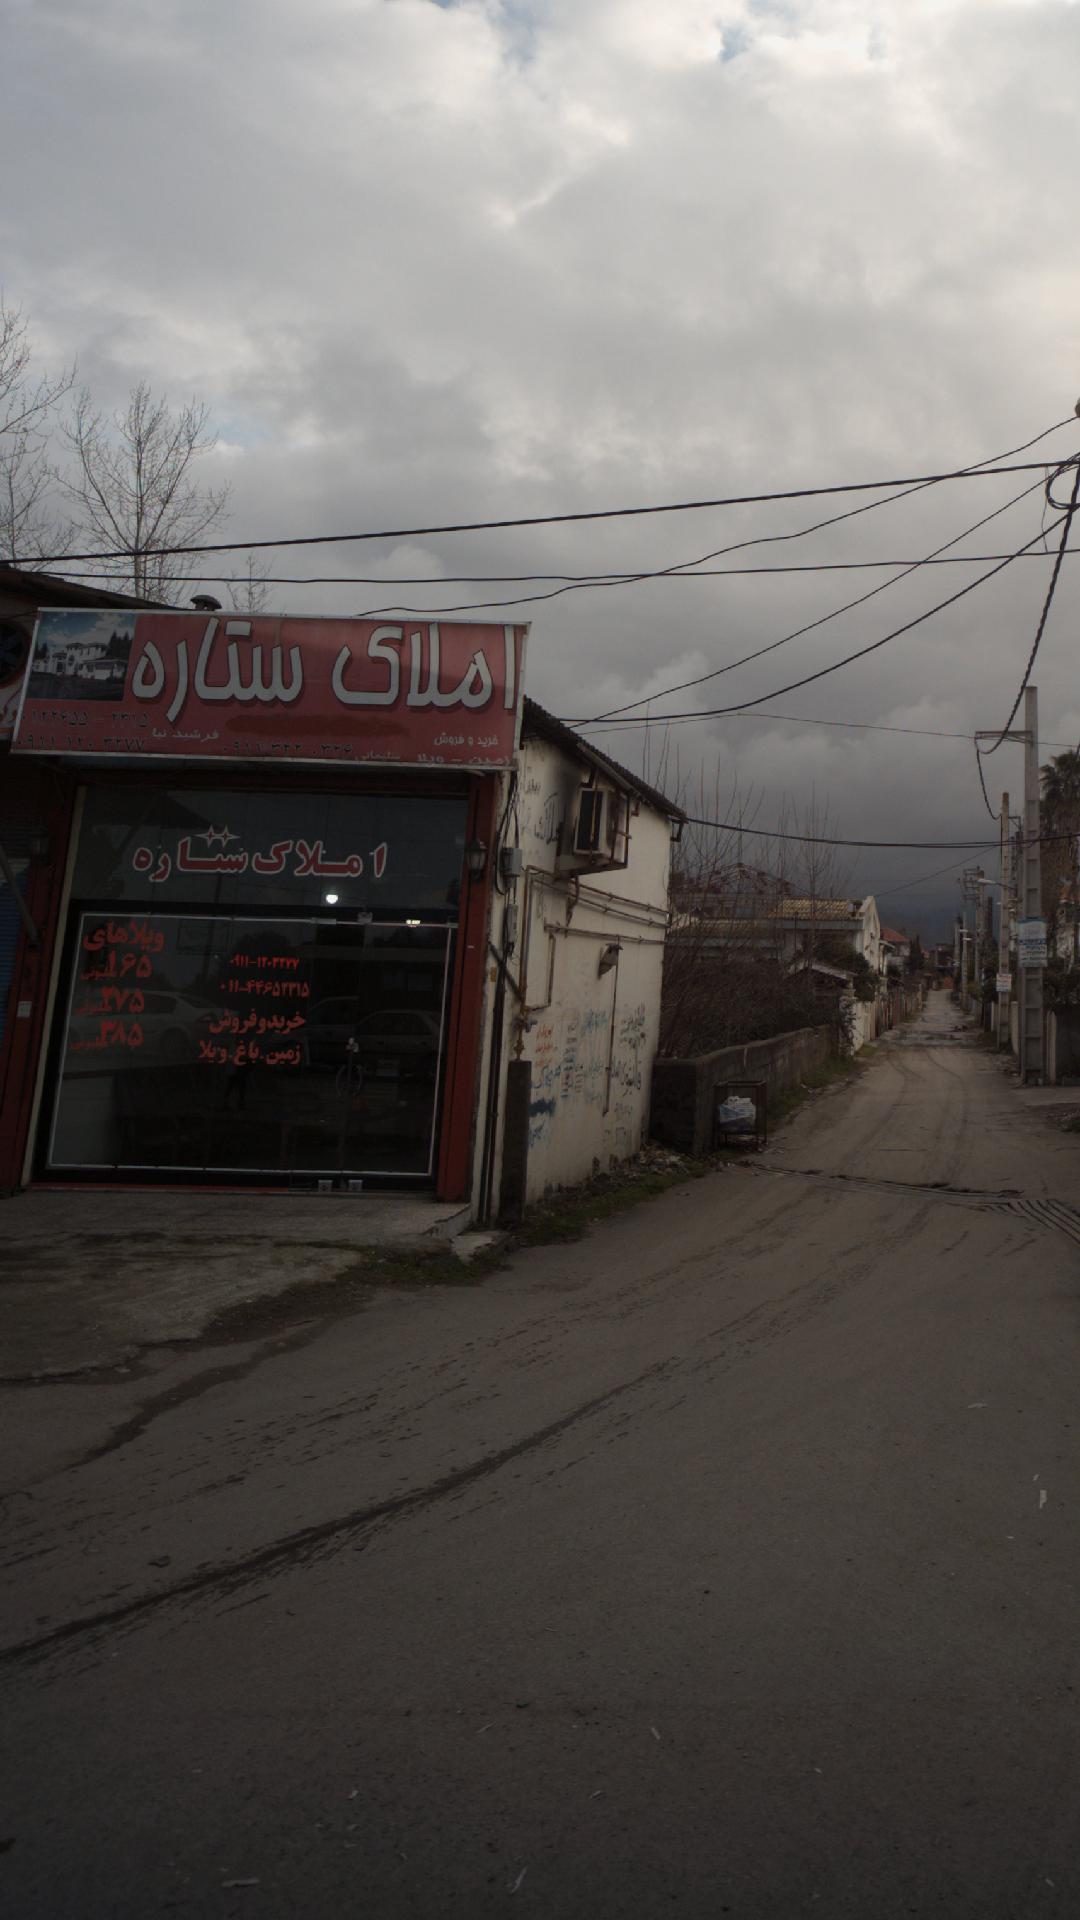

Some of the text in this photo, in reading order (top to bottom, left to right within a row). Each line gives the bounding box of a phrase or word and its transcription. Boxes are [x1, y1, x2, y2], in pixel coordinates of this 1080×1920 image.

[132, 615, 518, 724] املاک ستاره
[433, 731, 466, 747] فروش
[477, 733, 499, 748] خرید
[131, 823, 389, 883] املاک ستاره
[82, 917, 165, 953] ویلاهای
